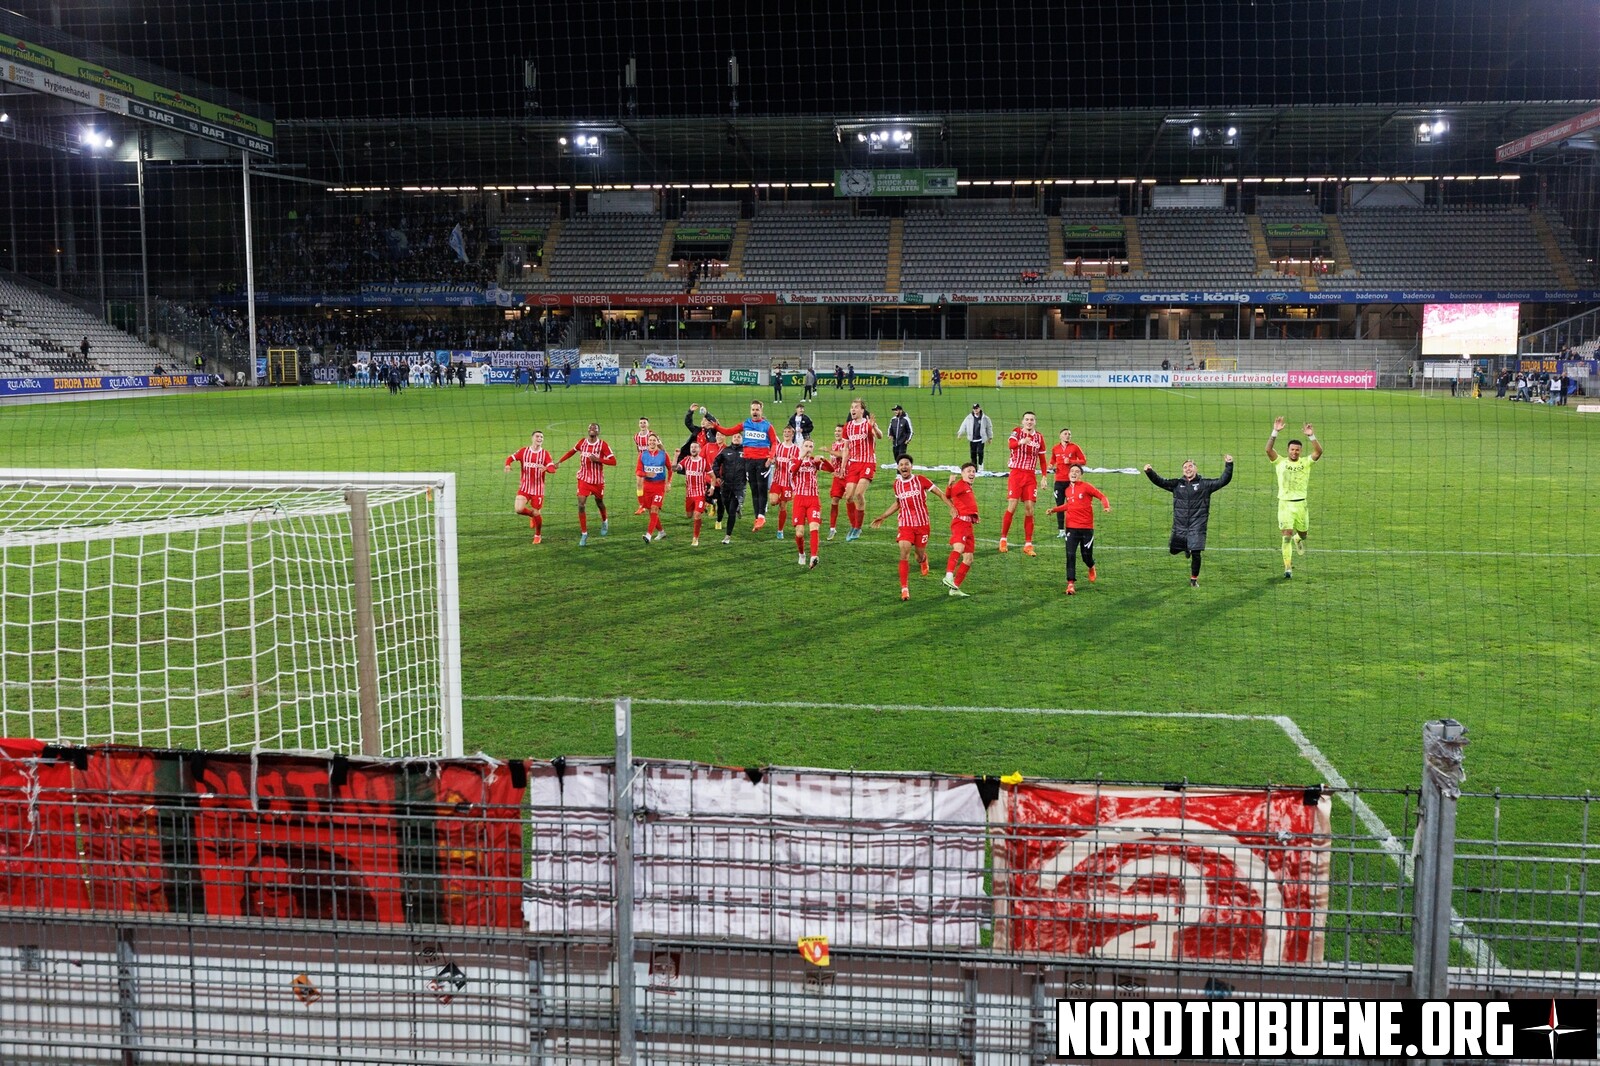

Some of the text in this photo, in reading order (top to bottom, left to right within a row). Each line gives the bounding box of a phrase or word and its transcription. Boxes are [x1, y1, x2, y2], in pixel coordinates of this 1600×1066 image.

[44, 78, 91, 100] Hygienehandel
[148, 109, 174, 124] RAFI
[202, 125, 225, 139] RAFI
[248, 139, 269, 152] RAFI
[572, 295, 612, 304] NEOPERL
[687, 295, 728, 304] NEOPERL
[791, 294, 898, 303] Rothaus TANNENZÄPFLE
[952, 294, 1062, 303] Rothaus TANNENZÄPFLE
[1140, 293, 1189, 301] ernst
[1203, 293, 1250, 303] könig
[493, 351, 541, 360] Vierkirchen
[1543, 361, 1558, 373] PARK
[490, 370, 510, 379] BGV
[644, 369, 685, 384] Rothaus
[949, 372, 978, 380] LOTTO
[1009, 372, 1038, 380] LOTTO
[1173, 374, 1285, 384] Druckerei Furtwängler
[54, 377, 82, 389] EUROPA
[83, 377, 102, 388] PARK
[173, 376, 188, 385] PARK
[1299, 375, 1342, 384] MAGENTA
[1344, 375, 1373, 384] SPORT
[865, 467, 871, 475] 9
[653, 494, 663, 503] 27
[698, 500, 704, 509] 8
